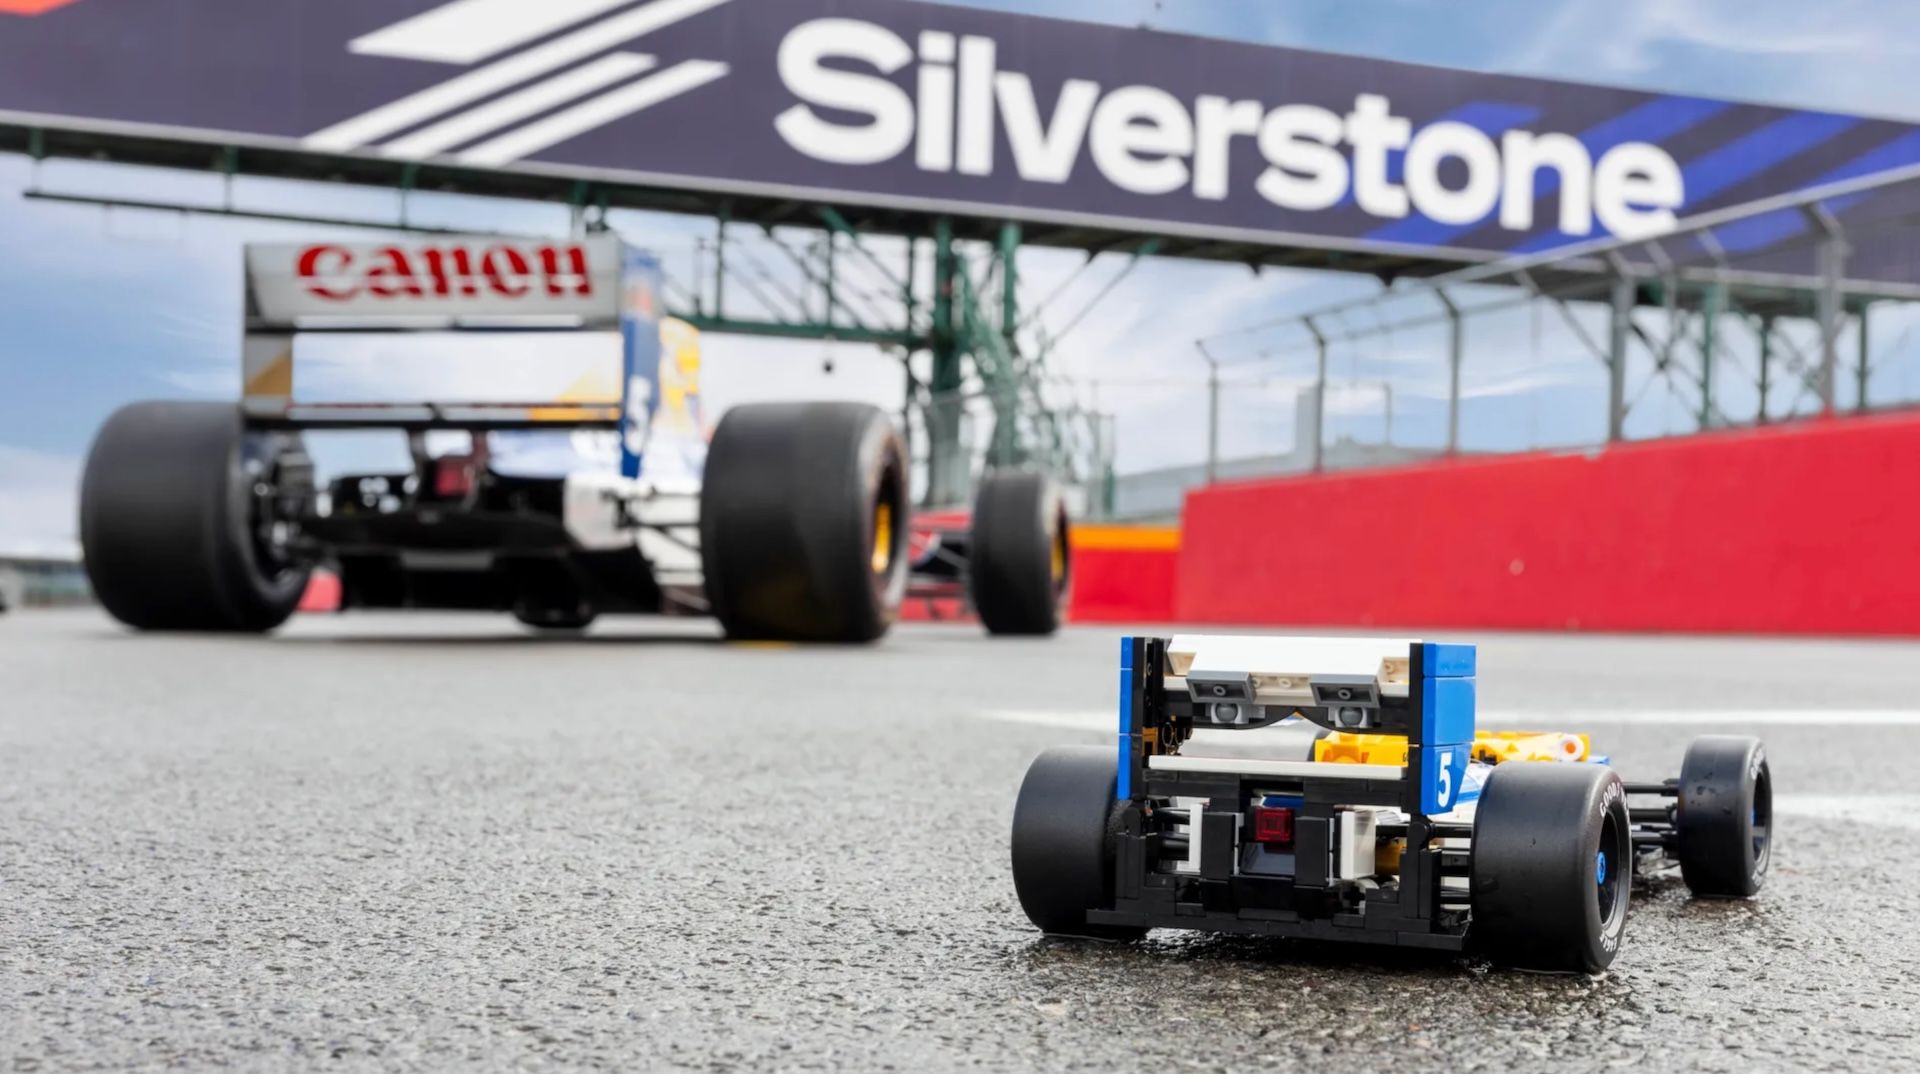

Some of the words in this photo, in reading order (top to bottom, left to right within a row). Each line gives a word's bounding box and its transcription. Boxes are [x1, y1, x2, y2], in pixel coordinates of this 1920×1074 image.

[774, 18, 1685, 239] Silverstone
[296, 243, 593, 300] Canon
[1438, 752, 1453, 808] 5
